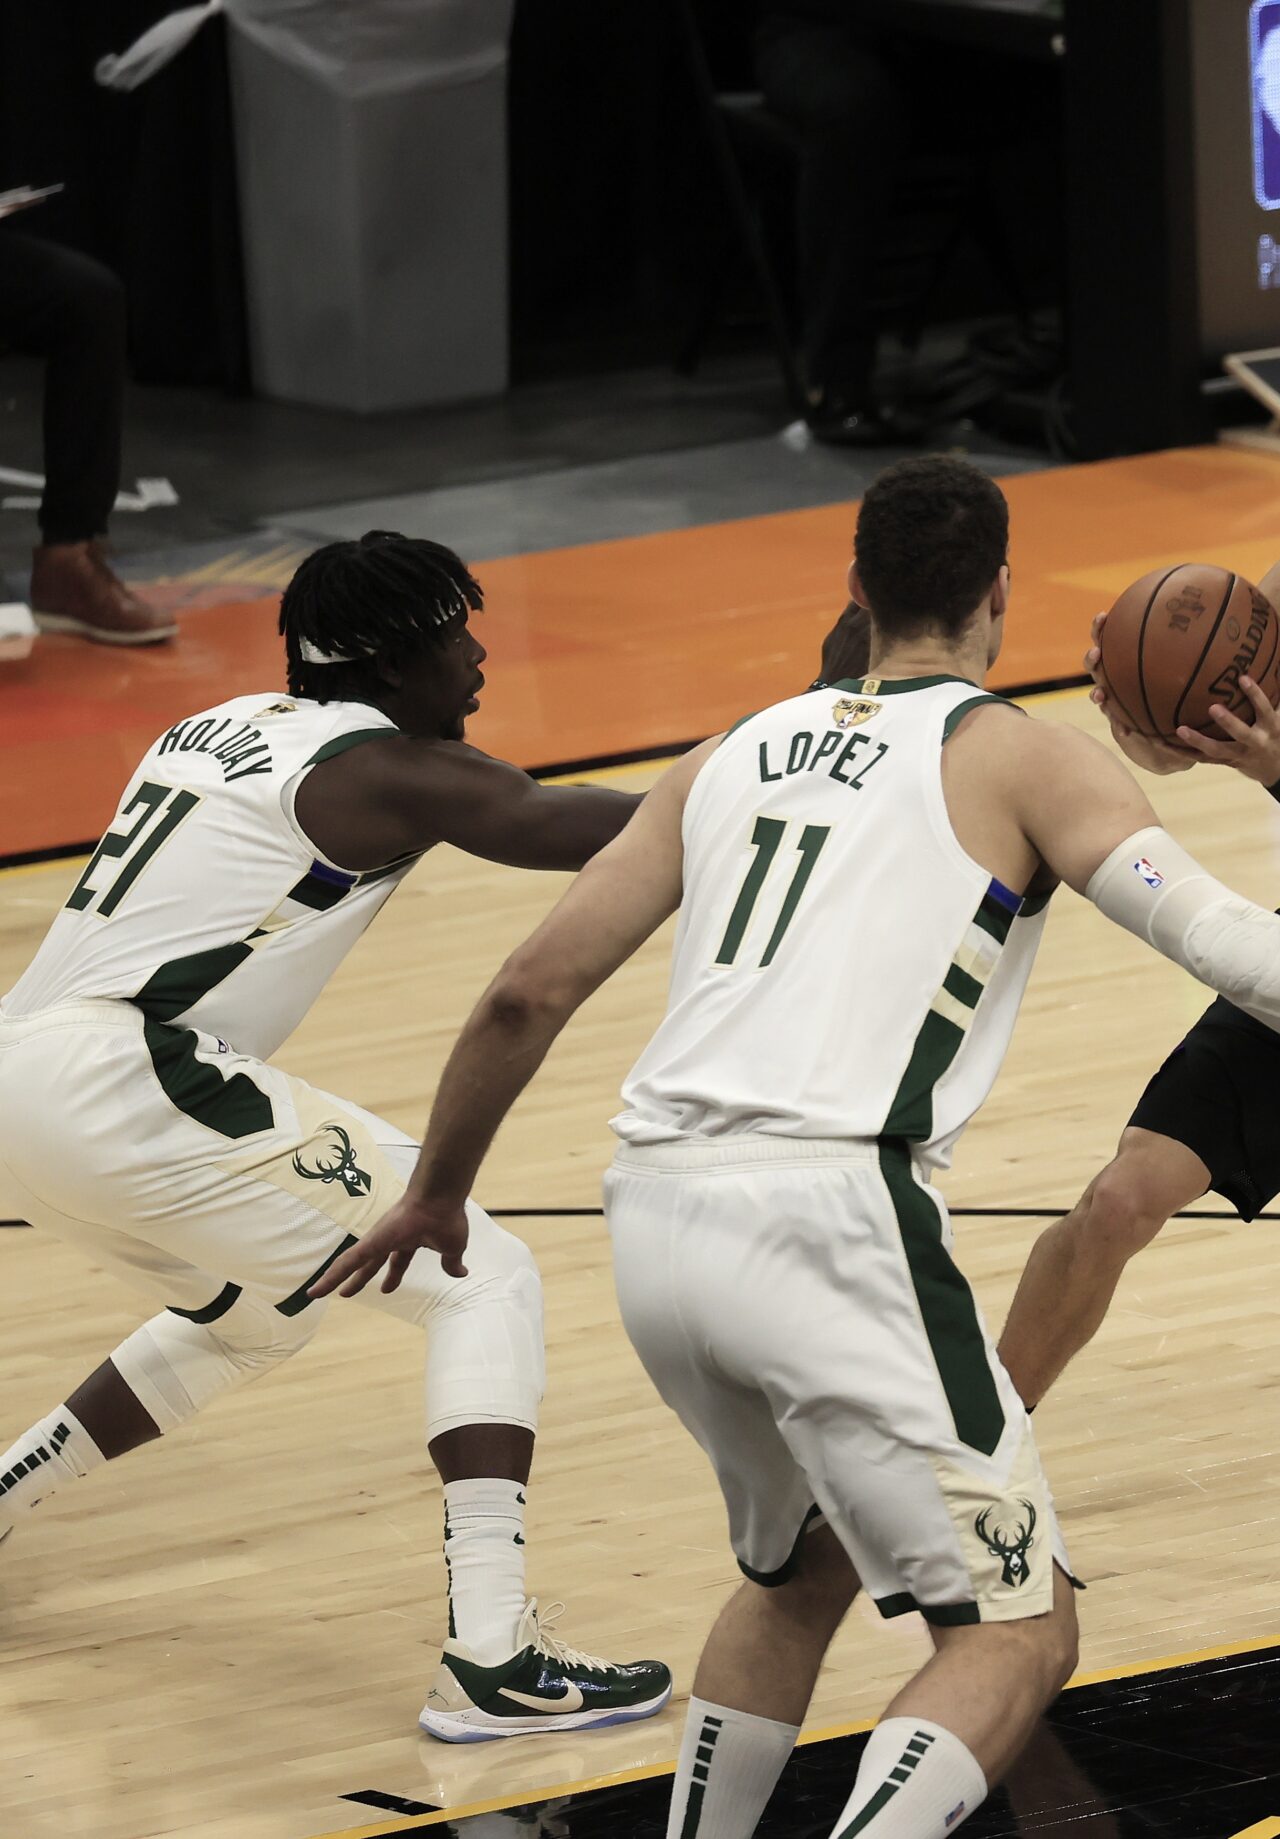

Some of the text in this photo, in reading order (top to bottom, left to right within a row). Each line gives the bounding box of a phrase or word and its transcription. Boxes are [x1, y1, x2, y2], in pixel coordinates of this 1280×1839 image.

[158, 718, 273, 783] HOLIDAY
[759, 730, 890, 791] LOPEZ
[65, 781, 201, 918] 21
[714, 816, 832, 969] 11
